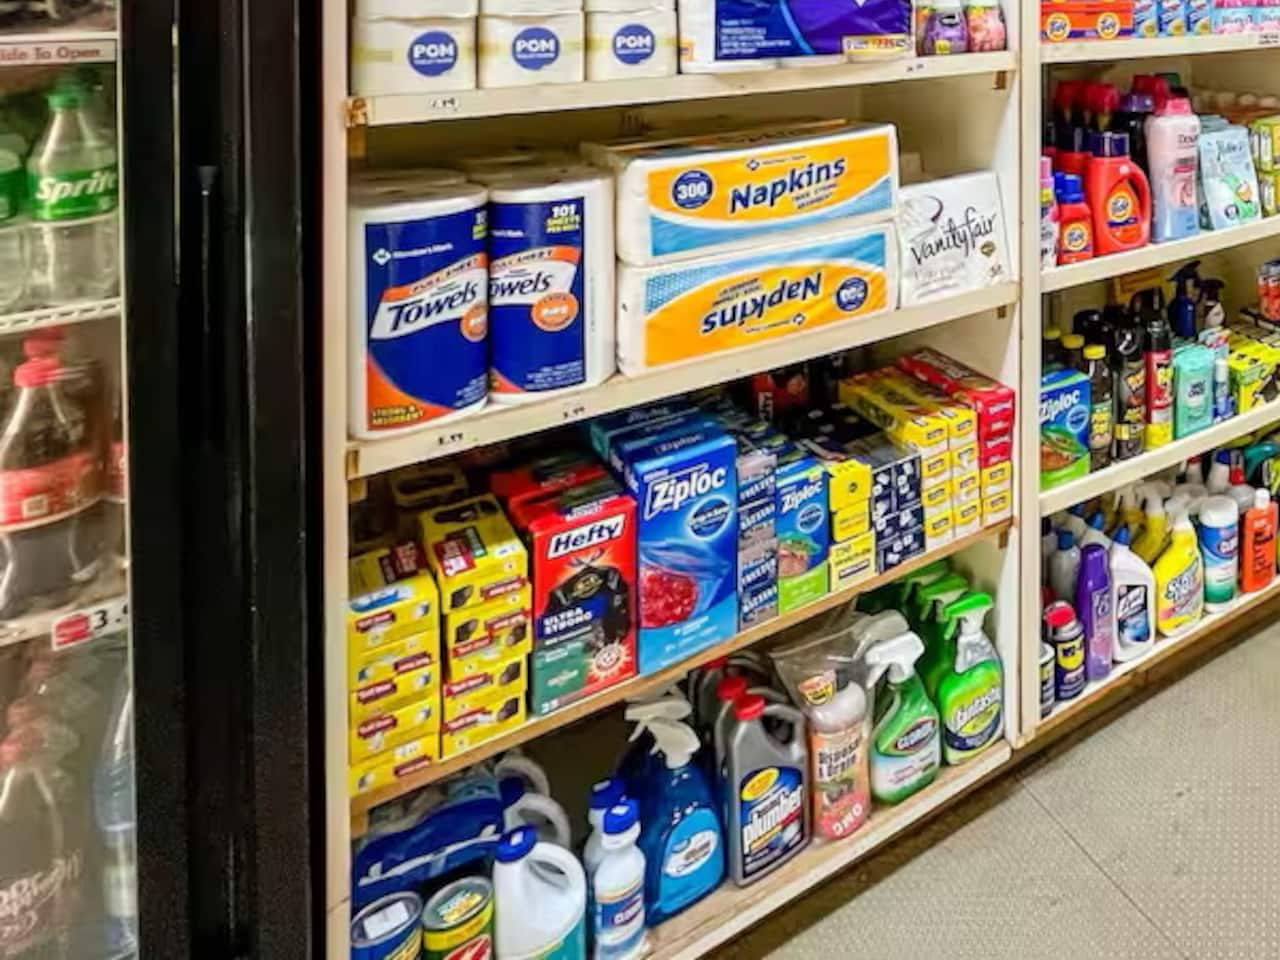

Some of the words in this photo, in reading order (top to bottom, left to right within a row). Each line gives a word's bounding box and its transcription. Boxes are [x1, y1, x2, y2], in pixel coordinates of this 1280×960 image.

[35, 46, 52, 60] To
[56, 46, 101, 61] Open
[36, 169, 118, 205] Sprit
[677, 181, 708, 200] 300
[729, 158, 846, 214] Napkins
[552, 204, 576, 218] 101
[489, 271, 553, 298] owels
[388, 281, 478, 333] Towels
[702, 272, 822, 334] Napkins
[652, 465, 727, 512] Ziploc
[781, 481, 823, 514] Ziploc
[552, 521, 620, 554] Hefty
